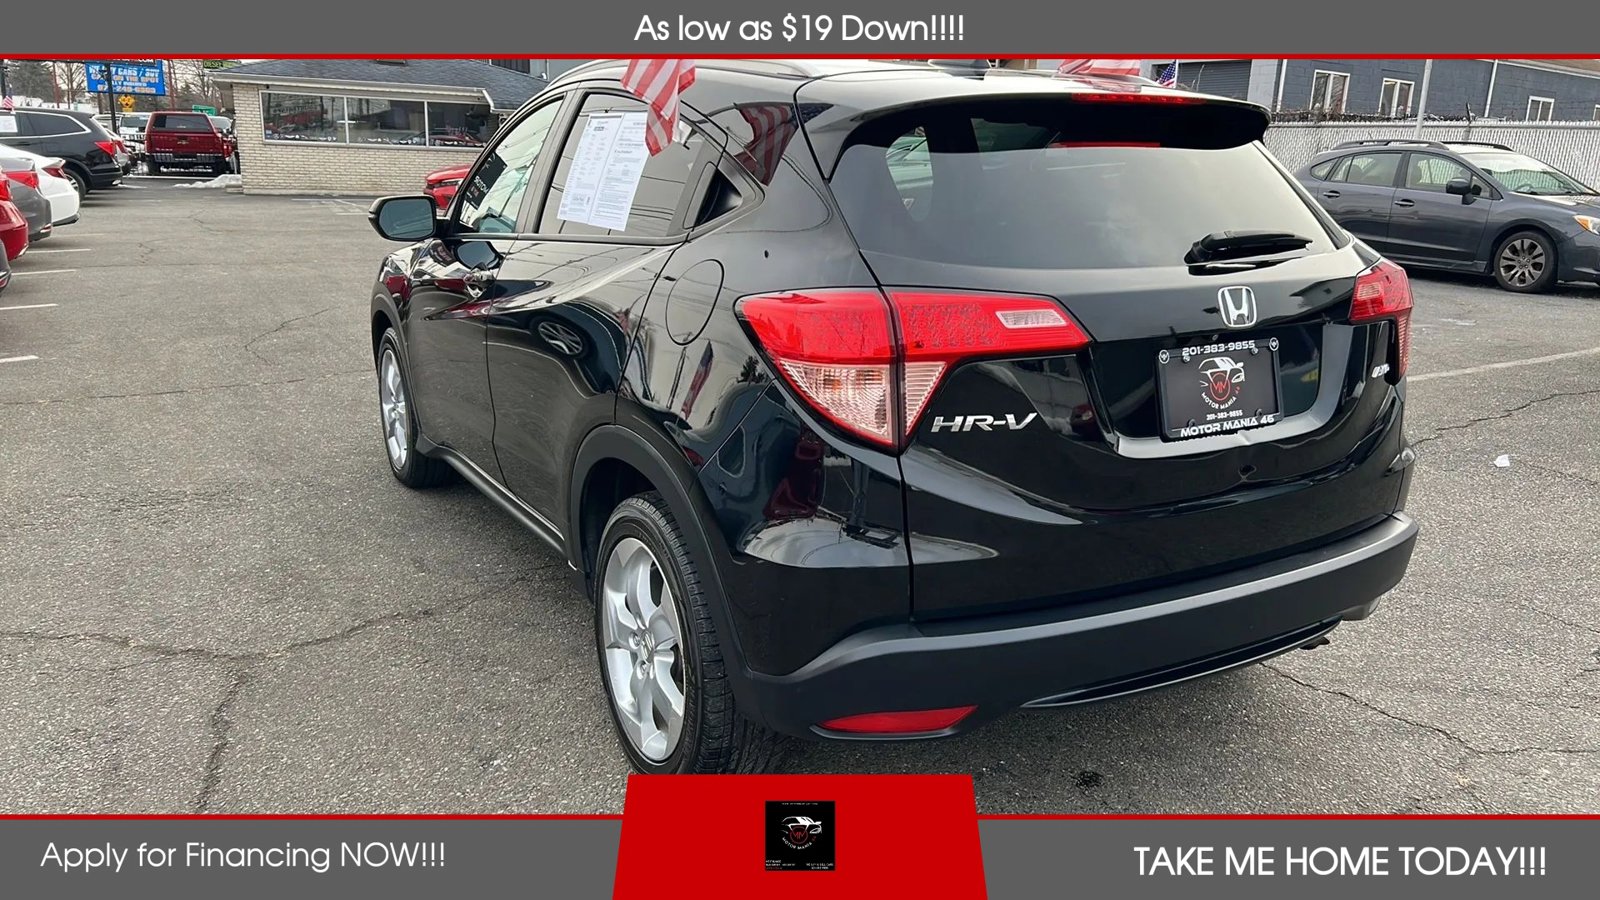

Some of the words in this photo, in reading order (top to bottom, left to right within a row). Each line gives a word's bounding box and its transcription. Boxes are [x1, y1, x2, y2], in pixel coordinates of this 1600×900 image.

[1182, 340, 1256, 356] 201-383-9855
[1201, 391, 1219, 409] MOTOR
[931, 412, 1038, 433] HR-V
[1180, 424, 1221, 438] MOTOR
[1223, 417, 1258, 431] MANIA
[1260, 415, 1275, 424] 46
